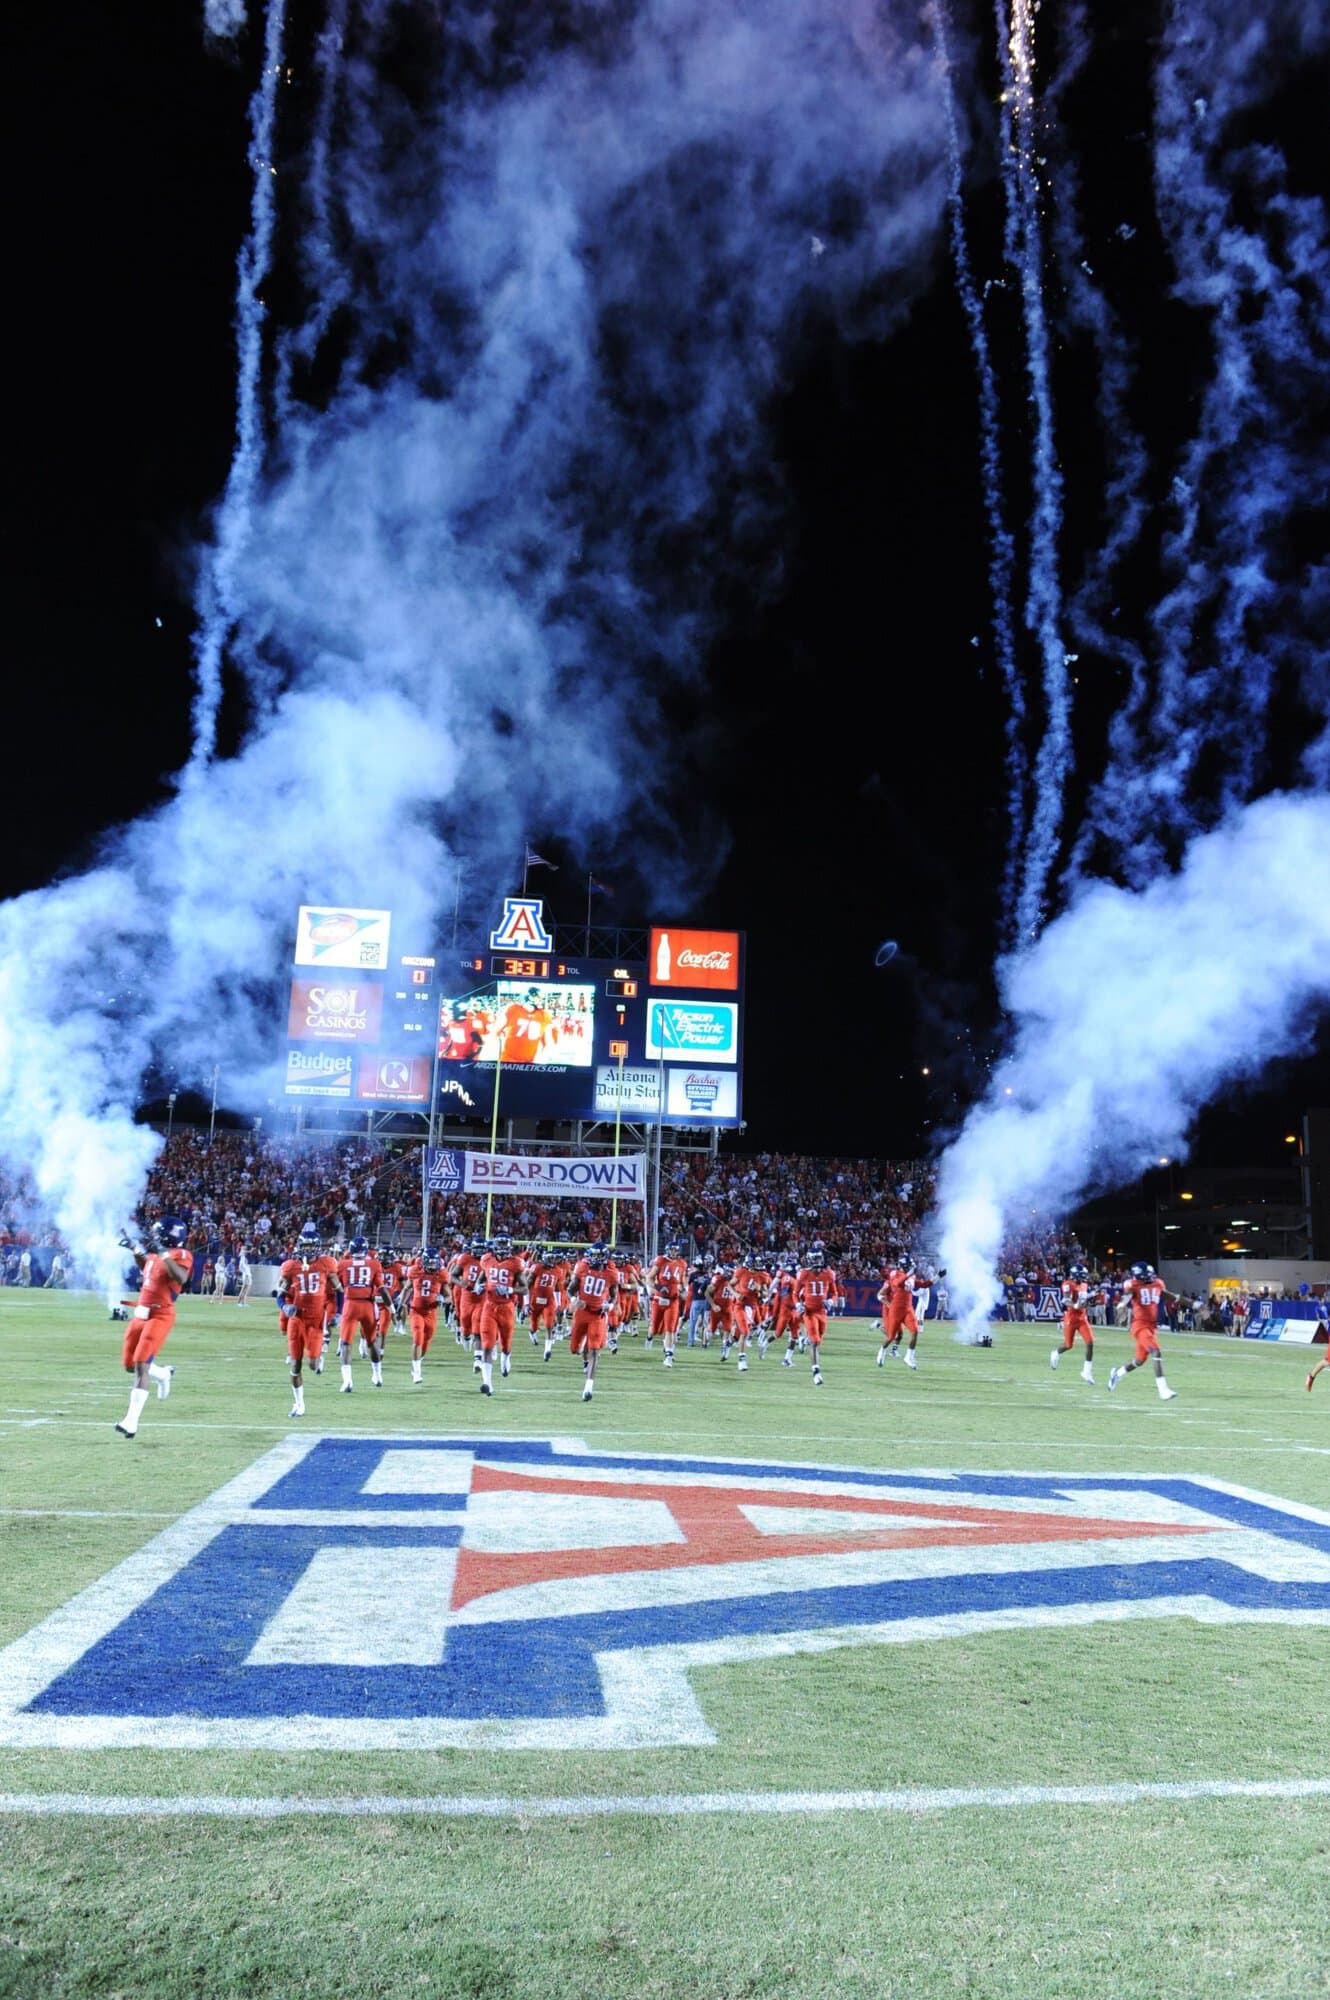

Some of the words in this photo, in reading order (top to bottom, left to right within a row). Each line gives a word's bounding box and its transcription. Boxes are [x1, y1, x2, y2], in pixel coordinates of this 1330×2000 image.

[490, 898, 552, 952] A
[460, 961, 473, 969] TOL
[474, 959, 482, 971] 3
[677, 949, 733, 970] Coca-Cola
[504, 959, 548, 977] 3:31
[558, 964, 566, 976] 3
[567, 967, 580, 975] TOL
[413, 970, 425, 984] 0
[624, 982, 636, 996] 0
[307, 987, 366, 1017] SOL
[306, 1016, 366, 1030] CASINOS
[672, 1009, 714, 1022] Tucson
[676, 1021, 725, 1034] Electric
[681, 1032, 724, 1044] Power
[288, 1051, 352, 1072] Budget
[605, 1069, 656, 1083] Arizona
[428, 1150, 460, 1179] A
[472, 1159, 549, 1181] BEAR
[549, 1163, 637, 1185] DOWN
[428, 1179, 459, 1190] CLUB
[347, 1266, 372, 1288] 18
[488, 1267, 509, 1285] 26
[540, 1273, 555, 1288] 21
[663, 1266, 680, 1280] 44
[297, 1272, 320, 1294] 16
[420, 1280, 431, 1297] 2
[583, 1275, 606, 1297] 80
[810, 1281, 824, 1297] 11
